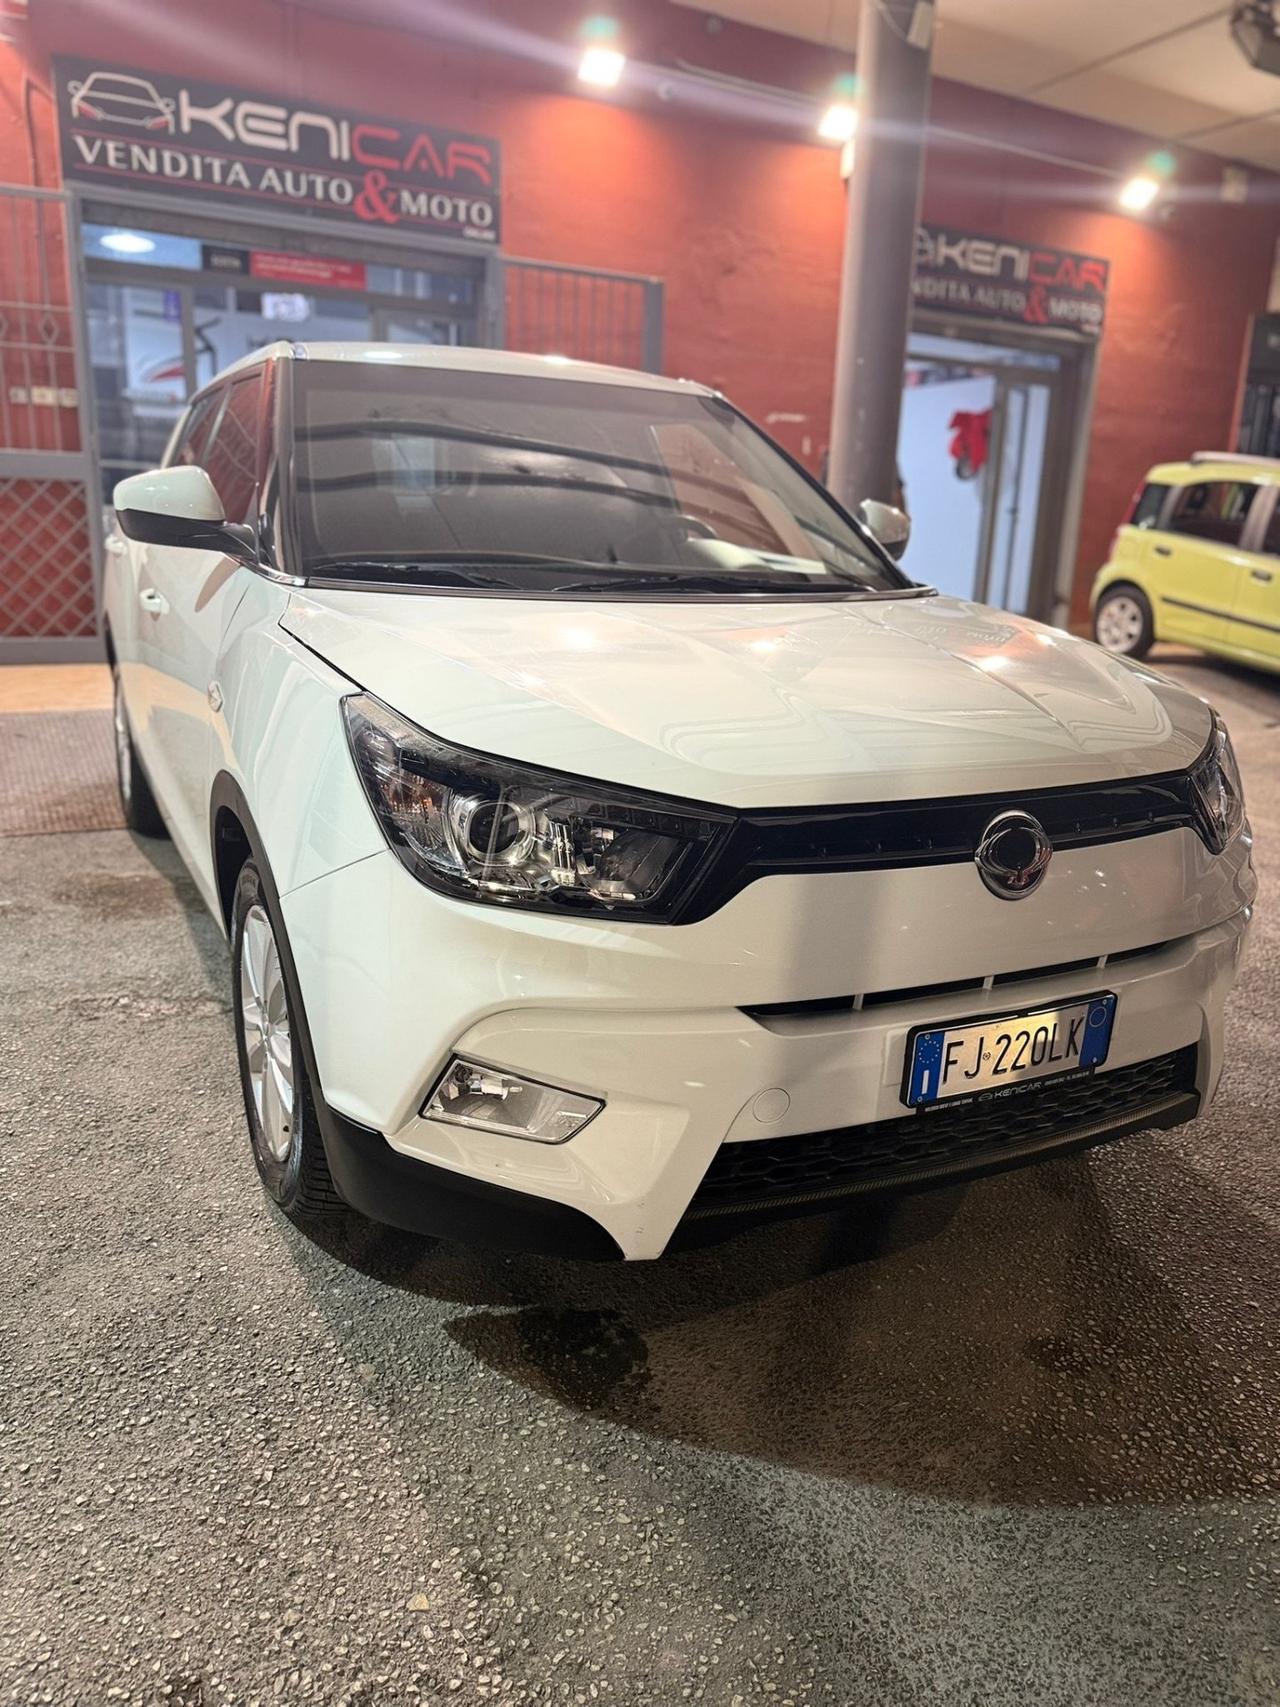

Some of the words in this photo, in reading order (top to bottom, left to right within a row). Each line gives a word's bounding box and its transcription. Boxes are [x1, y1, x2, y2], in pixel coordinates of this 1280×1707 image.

[179, 89, 493, 186] KENICAR
[73, 134, 251, 189] VENDITA
[258, 168, 354, 205] AUTO
[354, 169, 399, 224] &
[400, 190, 493, 228] MOTO
[937, 234, 1106, 291] KENICAR
[975, 285, 1026, 312] AUTO
[1023, 284, 1048, 324] &
[1048, 297, 1102, 323] MOTO
